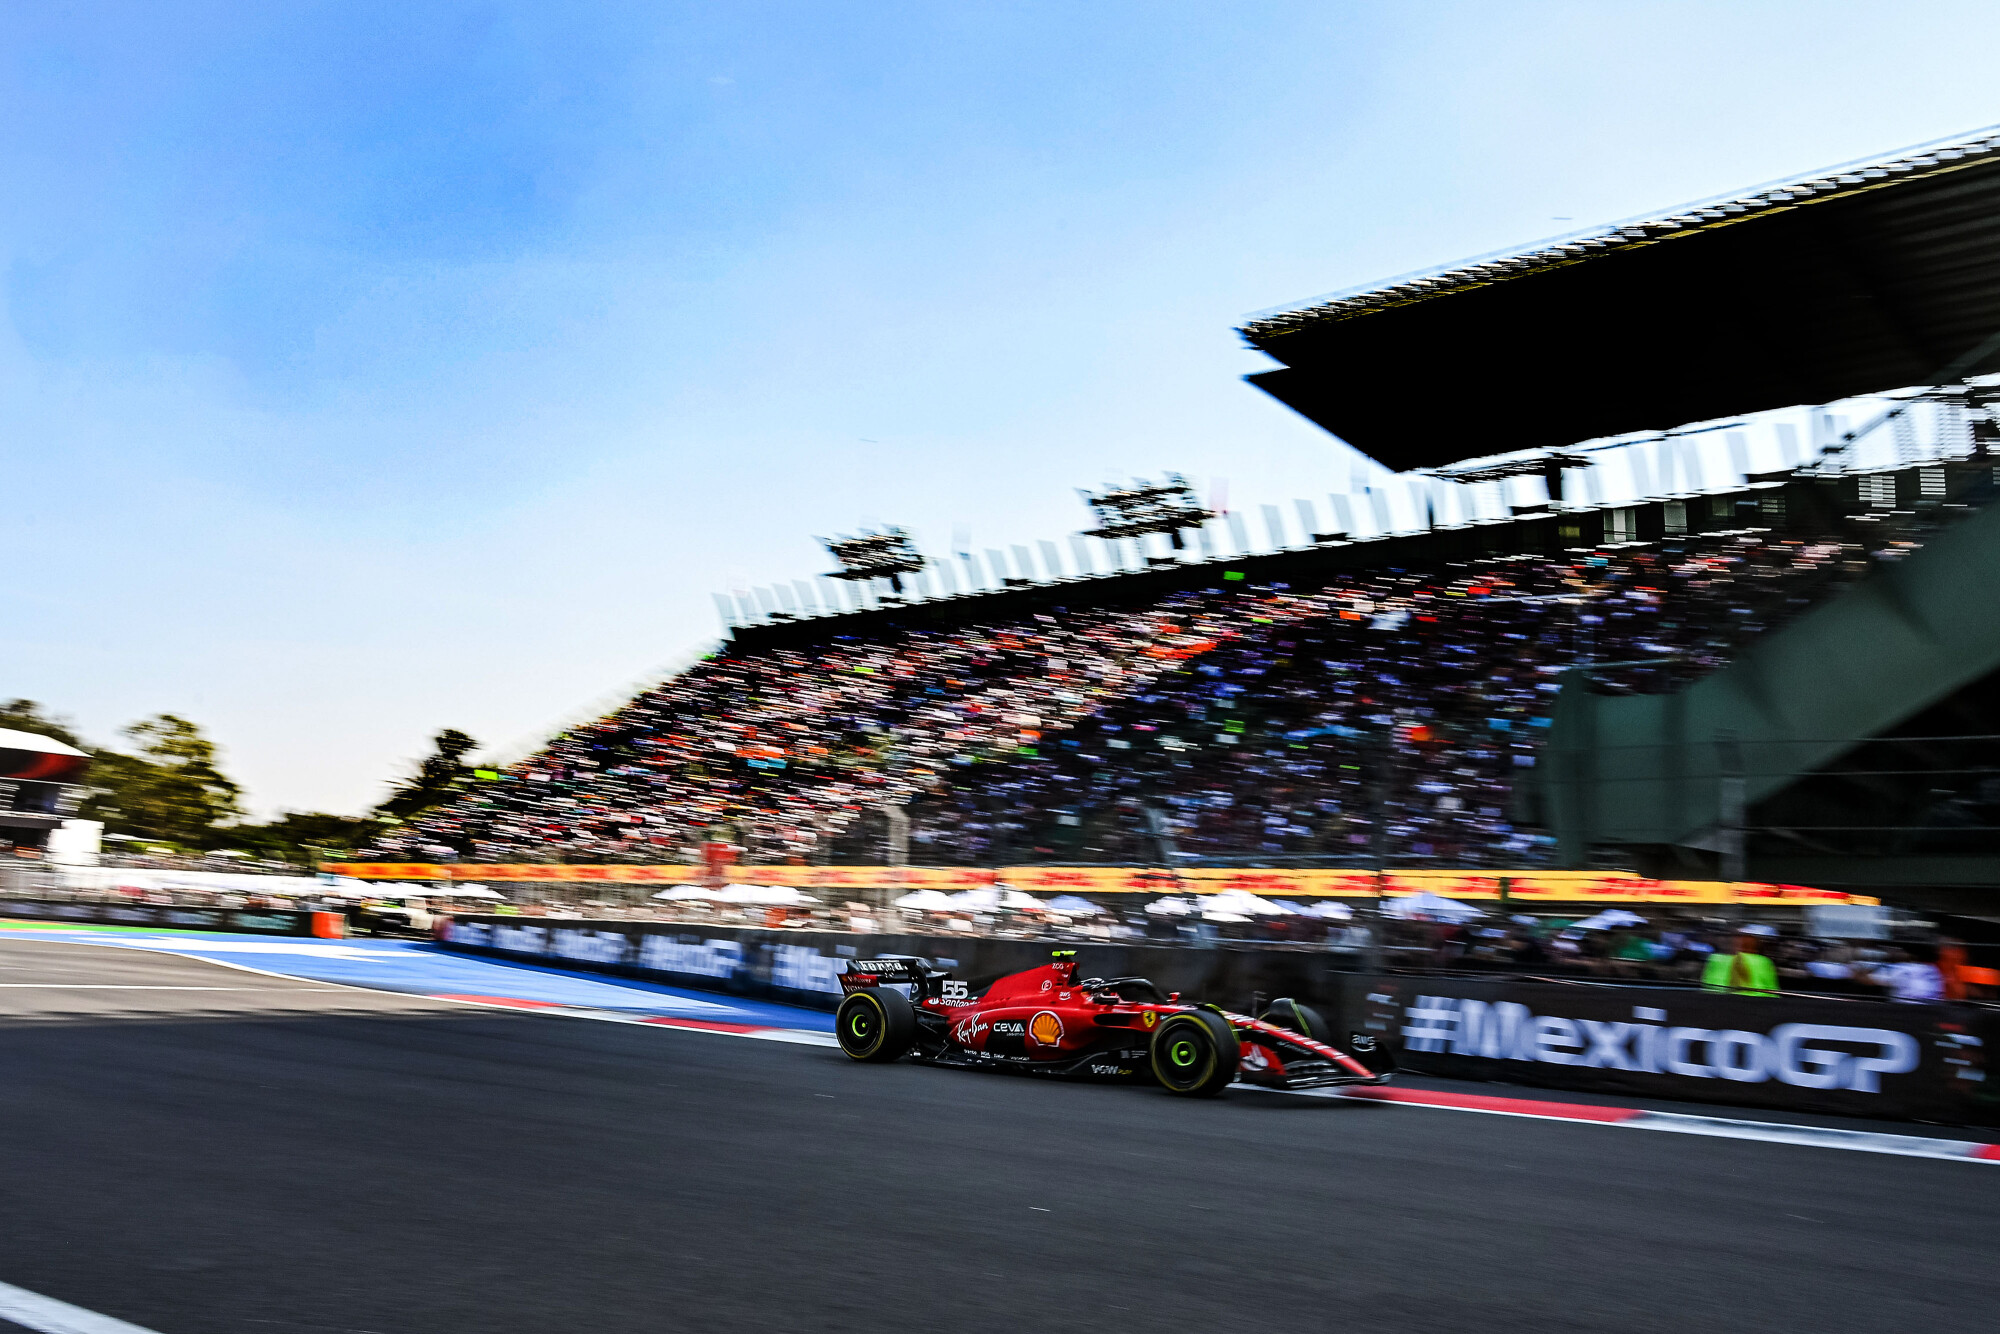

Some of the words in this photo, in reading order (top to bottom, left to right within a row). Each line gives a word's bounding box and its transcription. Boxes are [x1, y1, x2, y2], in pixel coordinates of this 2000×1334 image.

[942, 980, 968, 999] 55
[957, 1012, 989, 1043] Ray-Ban
[1400, 994, 1921, 1094] #MexicoGP
